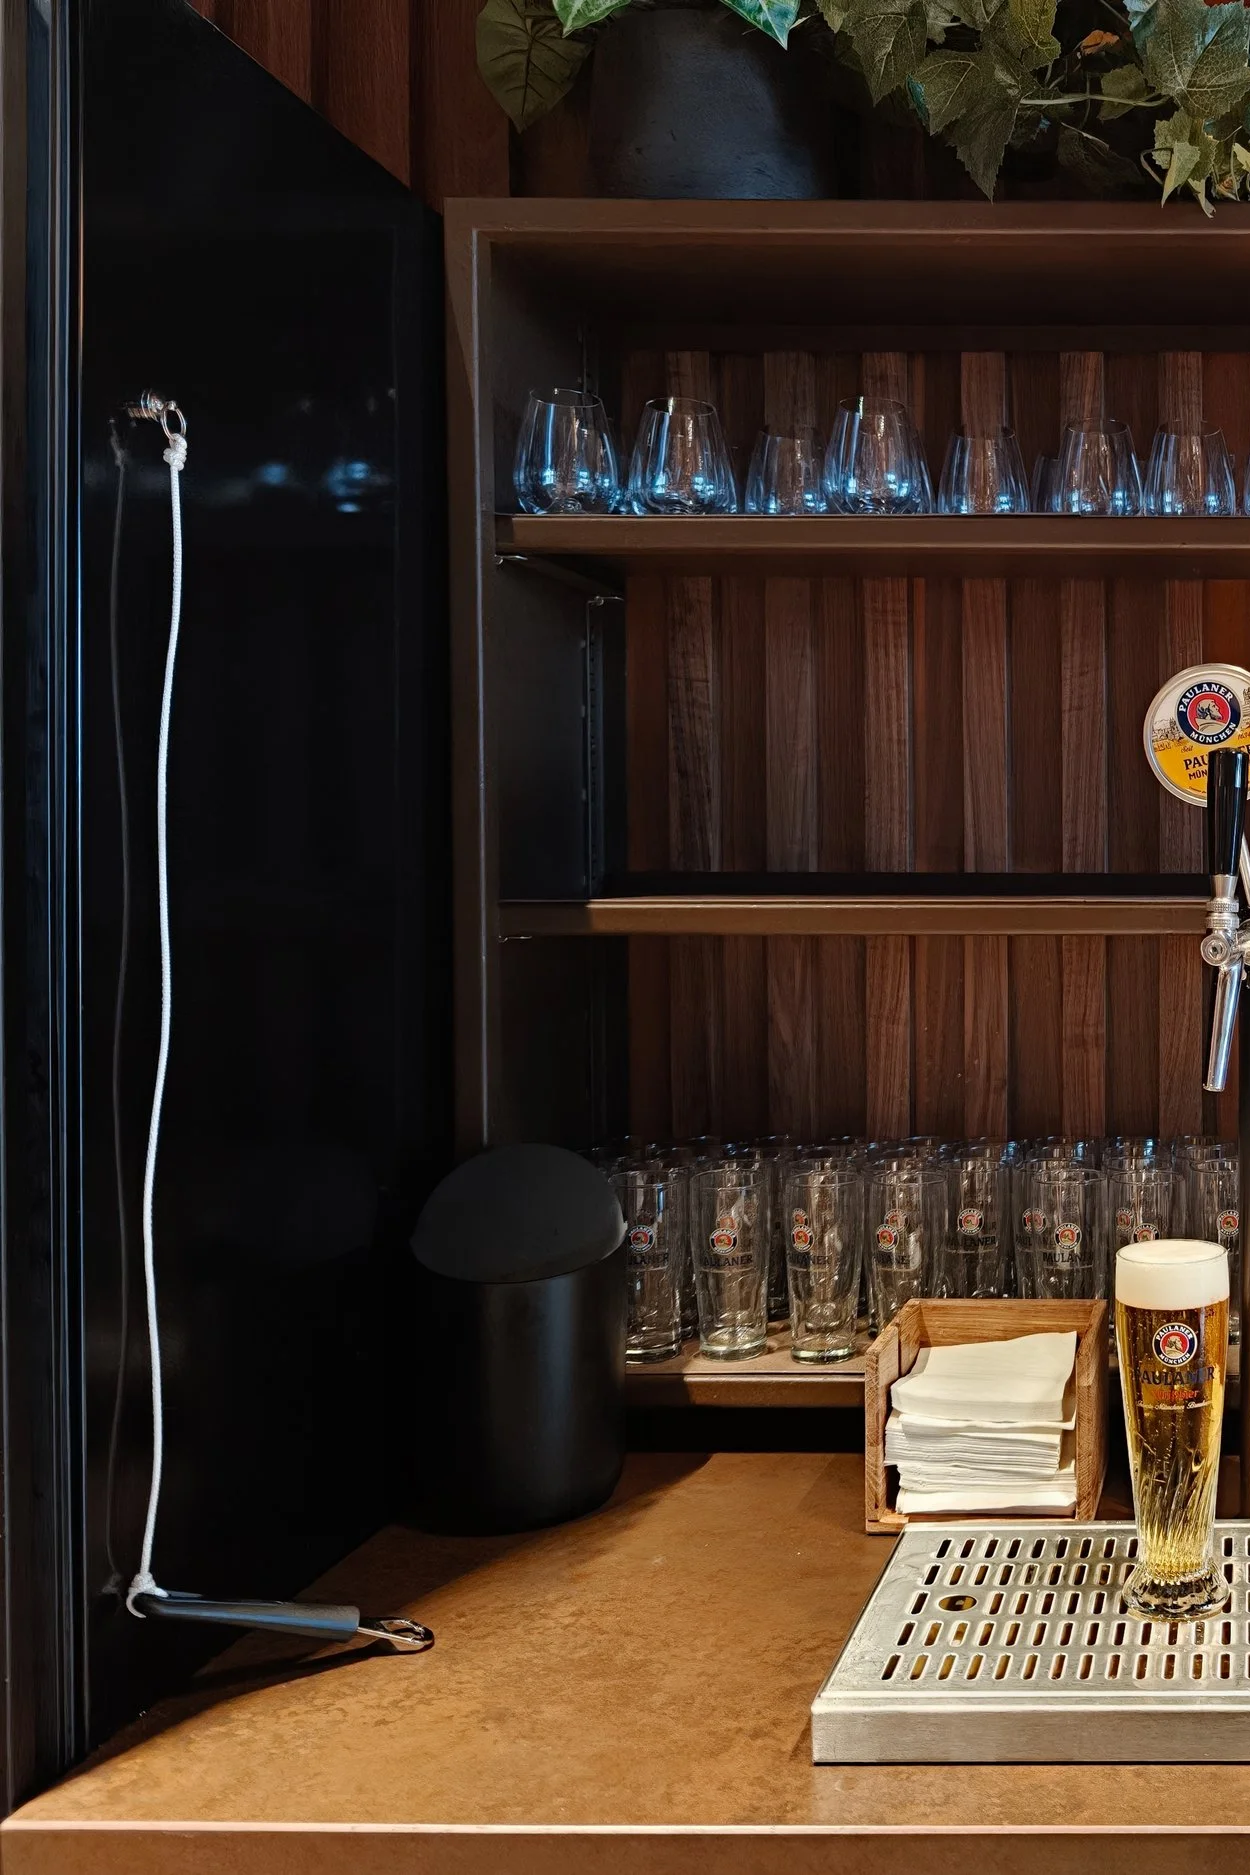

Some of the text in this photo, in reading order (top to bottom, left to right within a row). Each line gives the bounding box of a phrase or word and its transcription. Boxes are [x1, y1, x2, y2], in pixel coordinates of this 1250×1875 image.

[1179, 683, 1233, 713] PAULANER
[1190, 722, 1237, 744] MÜNCHEN
[1156, 1324, 1193, 1341] PAULANER
